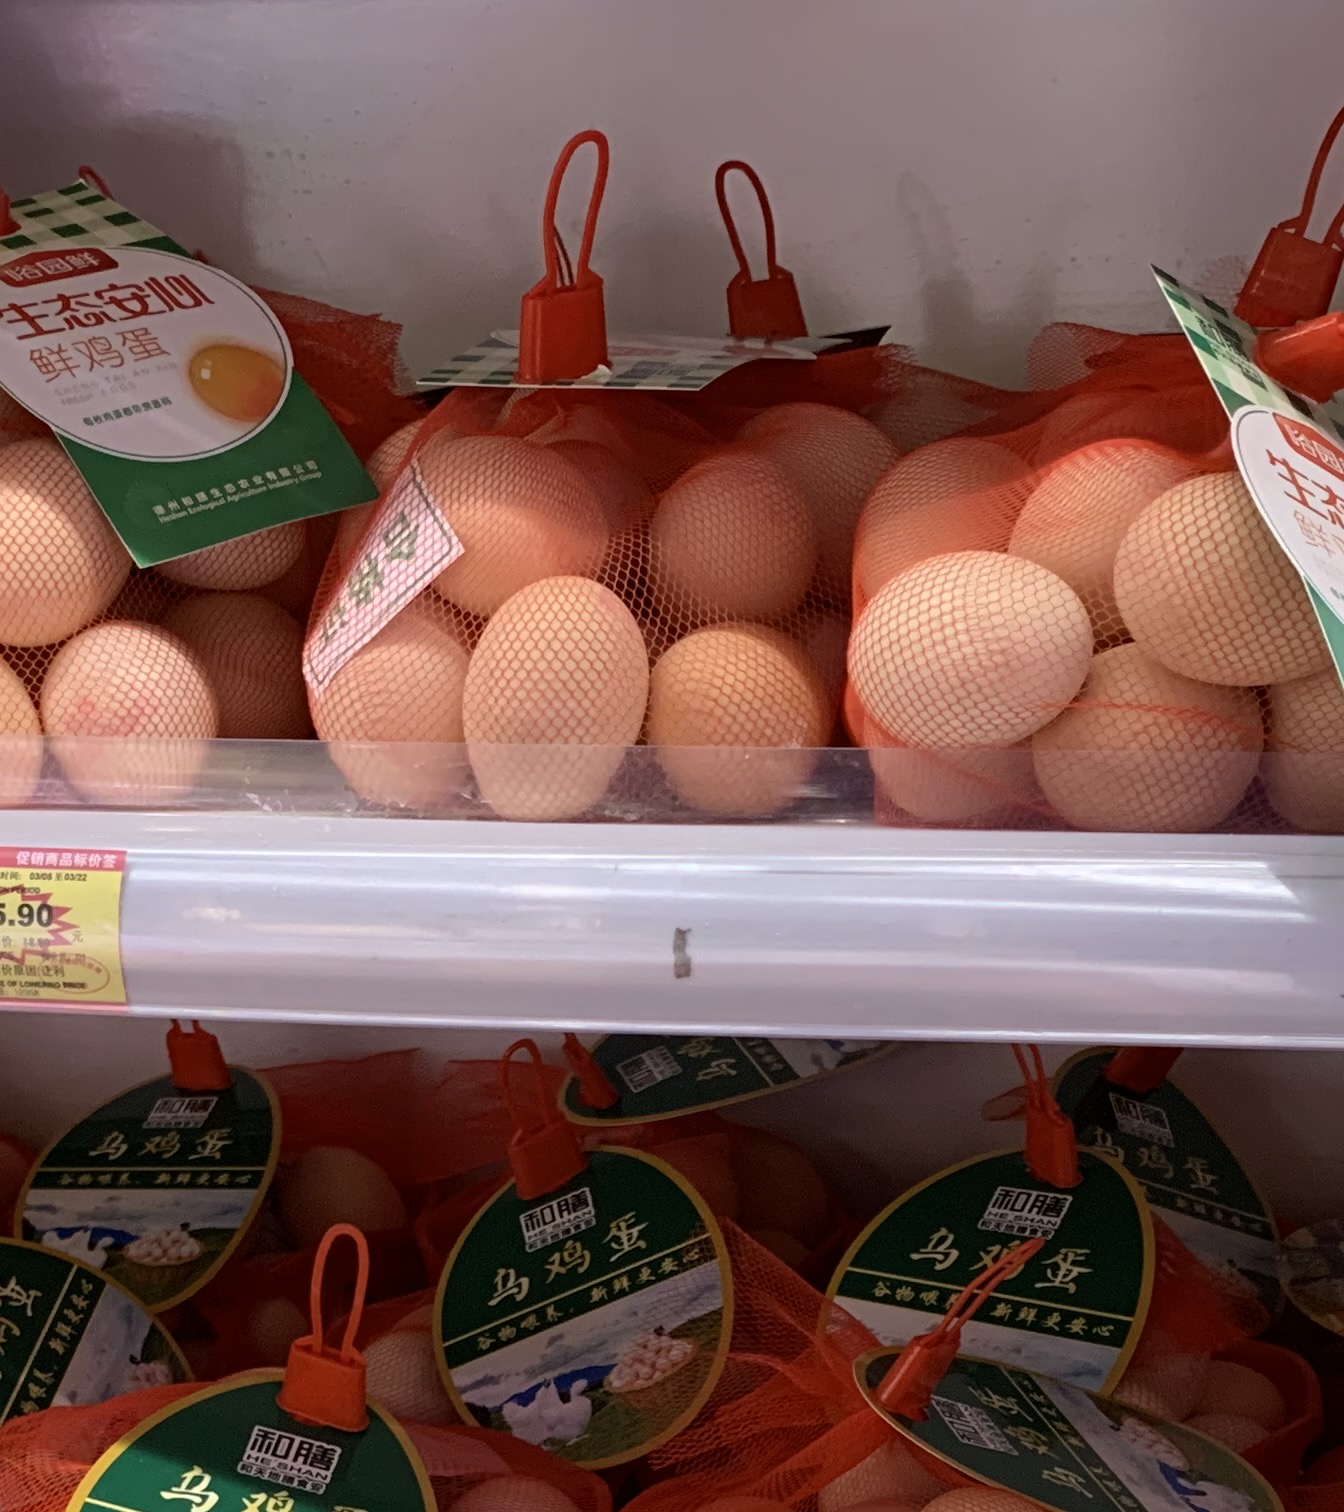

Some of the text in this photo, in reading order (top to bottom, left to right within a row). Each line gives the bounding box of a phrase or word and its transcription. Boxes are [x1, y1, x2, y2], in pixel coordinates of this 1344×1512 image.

[28, 326, 172, 383] 鲜鸡蛋
[16, 850, 117, 868] 促销商品标价签
[64, 873, 87, 882] 03/22
[72, 931, 83, 943] 元
[89, 1128, 232, 1160] 乌鸡蛋
[522, 1189, 594, 1233] 和膳
[994, 1187, 1072, 1218] 和膳
[1014, 1213, 1059, 1229] SHAN
[488, 1211, 650, 1307] 乌鸡蛋
[909, 1227, 1095, 1295] 乌鸡蛋
[251, 1427, 341, 1472] 和膳
[245, 1452, 329, 1481] HE SHAN
